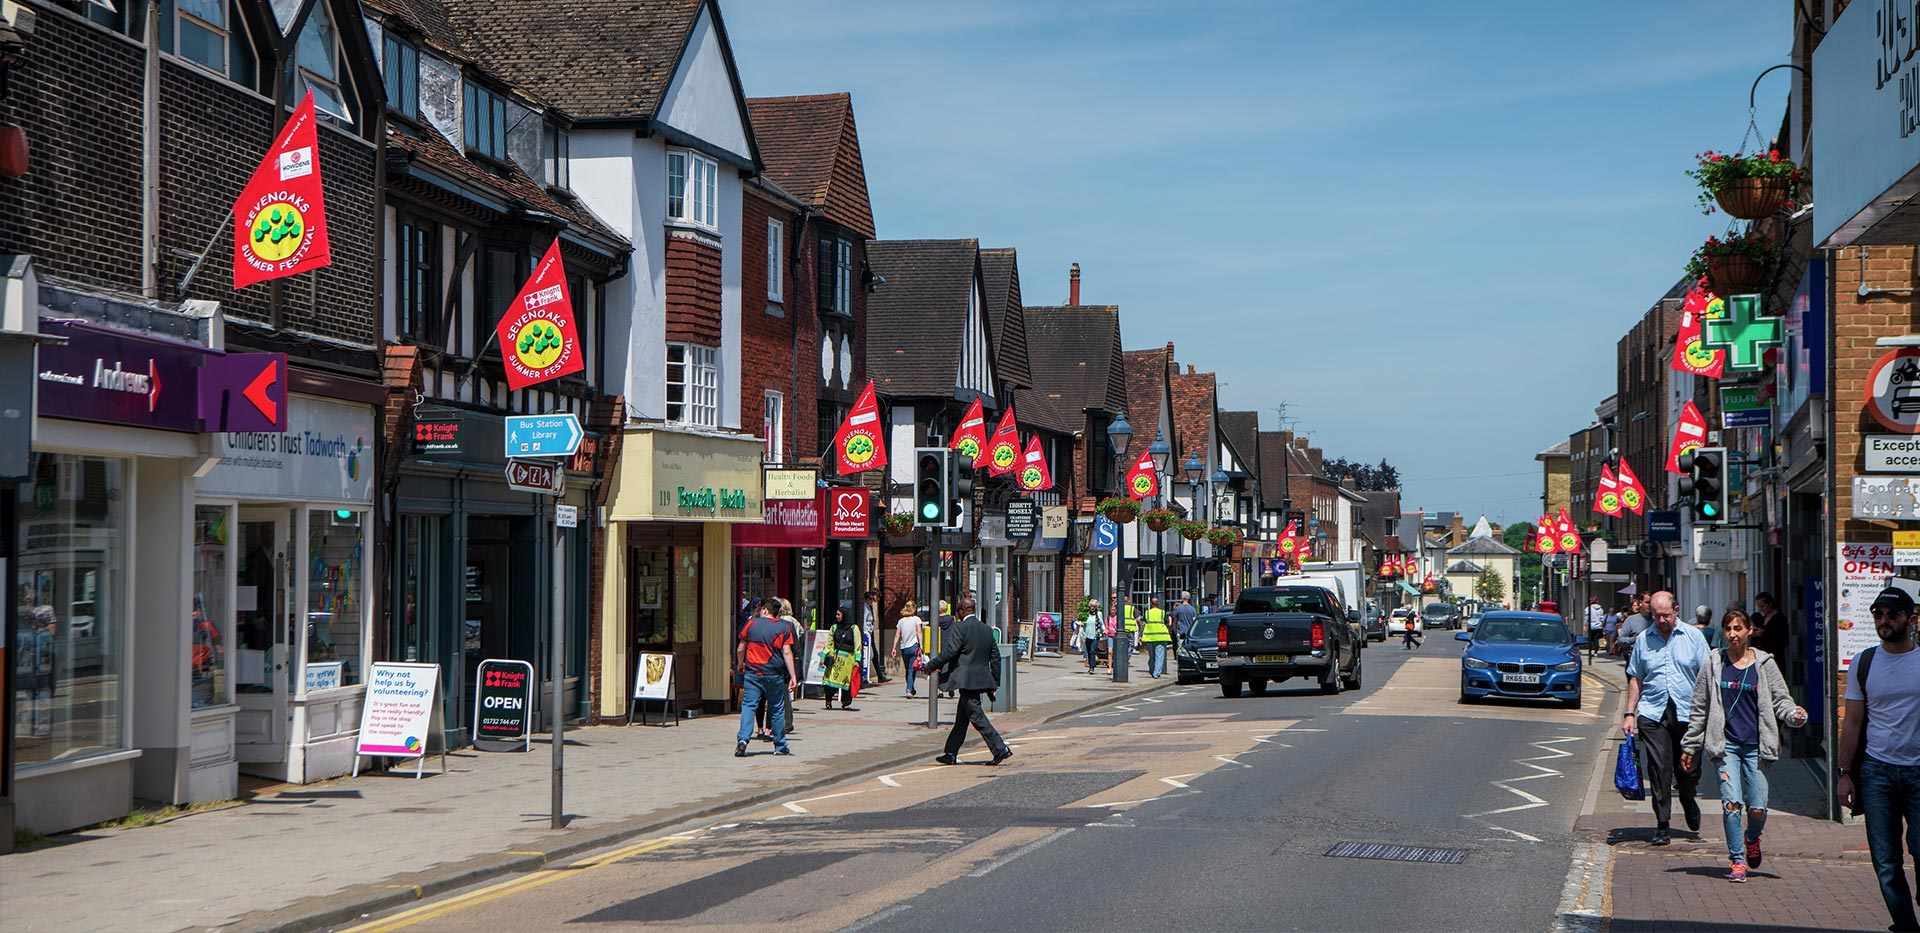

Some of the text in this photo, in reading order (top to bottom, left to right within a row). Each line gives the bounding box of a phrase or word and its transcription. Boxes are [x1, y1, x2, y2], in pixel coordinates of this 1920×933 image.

[244, 190, 310, 228] SEVENOAKS
[241, 225, 315, 272] SUMMER FESTIVAL
[507, 310, 567, 341] SEVENOAKS
[509, 338, 573, 378] SUMMER FESTIVAL
[93, 358, 149, 395] Andrews
[432, 423, 458, 433] Knight
[520, 419, 563, 429] Bus Station
[432, 432, 455, 441] Frank
[532, 431, 557, 440] Library
[843, 429, 876, 448] SEVENOAKS
[228, 432, 346, 459] Children's Trust Tadworth
[659, 489, 671, 506] 119
[719, 488, 746, 512] Health
[779, 502, 818, 527] Foundation
[1099, 522, 1114, 546] S
[1843, 561, 1894, 573] OPEN
[376, 670, 395, 680] Why
[501, 672, 526, 681] Knight
[406, 680, 416, 688] by
[501, 680, 521, 688] Frank
[373, 688, 429, 698] volunteering?
[484, 696, 523, 710] OPEN
